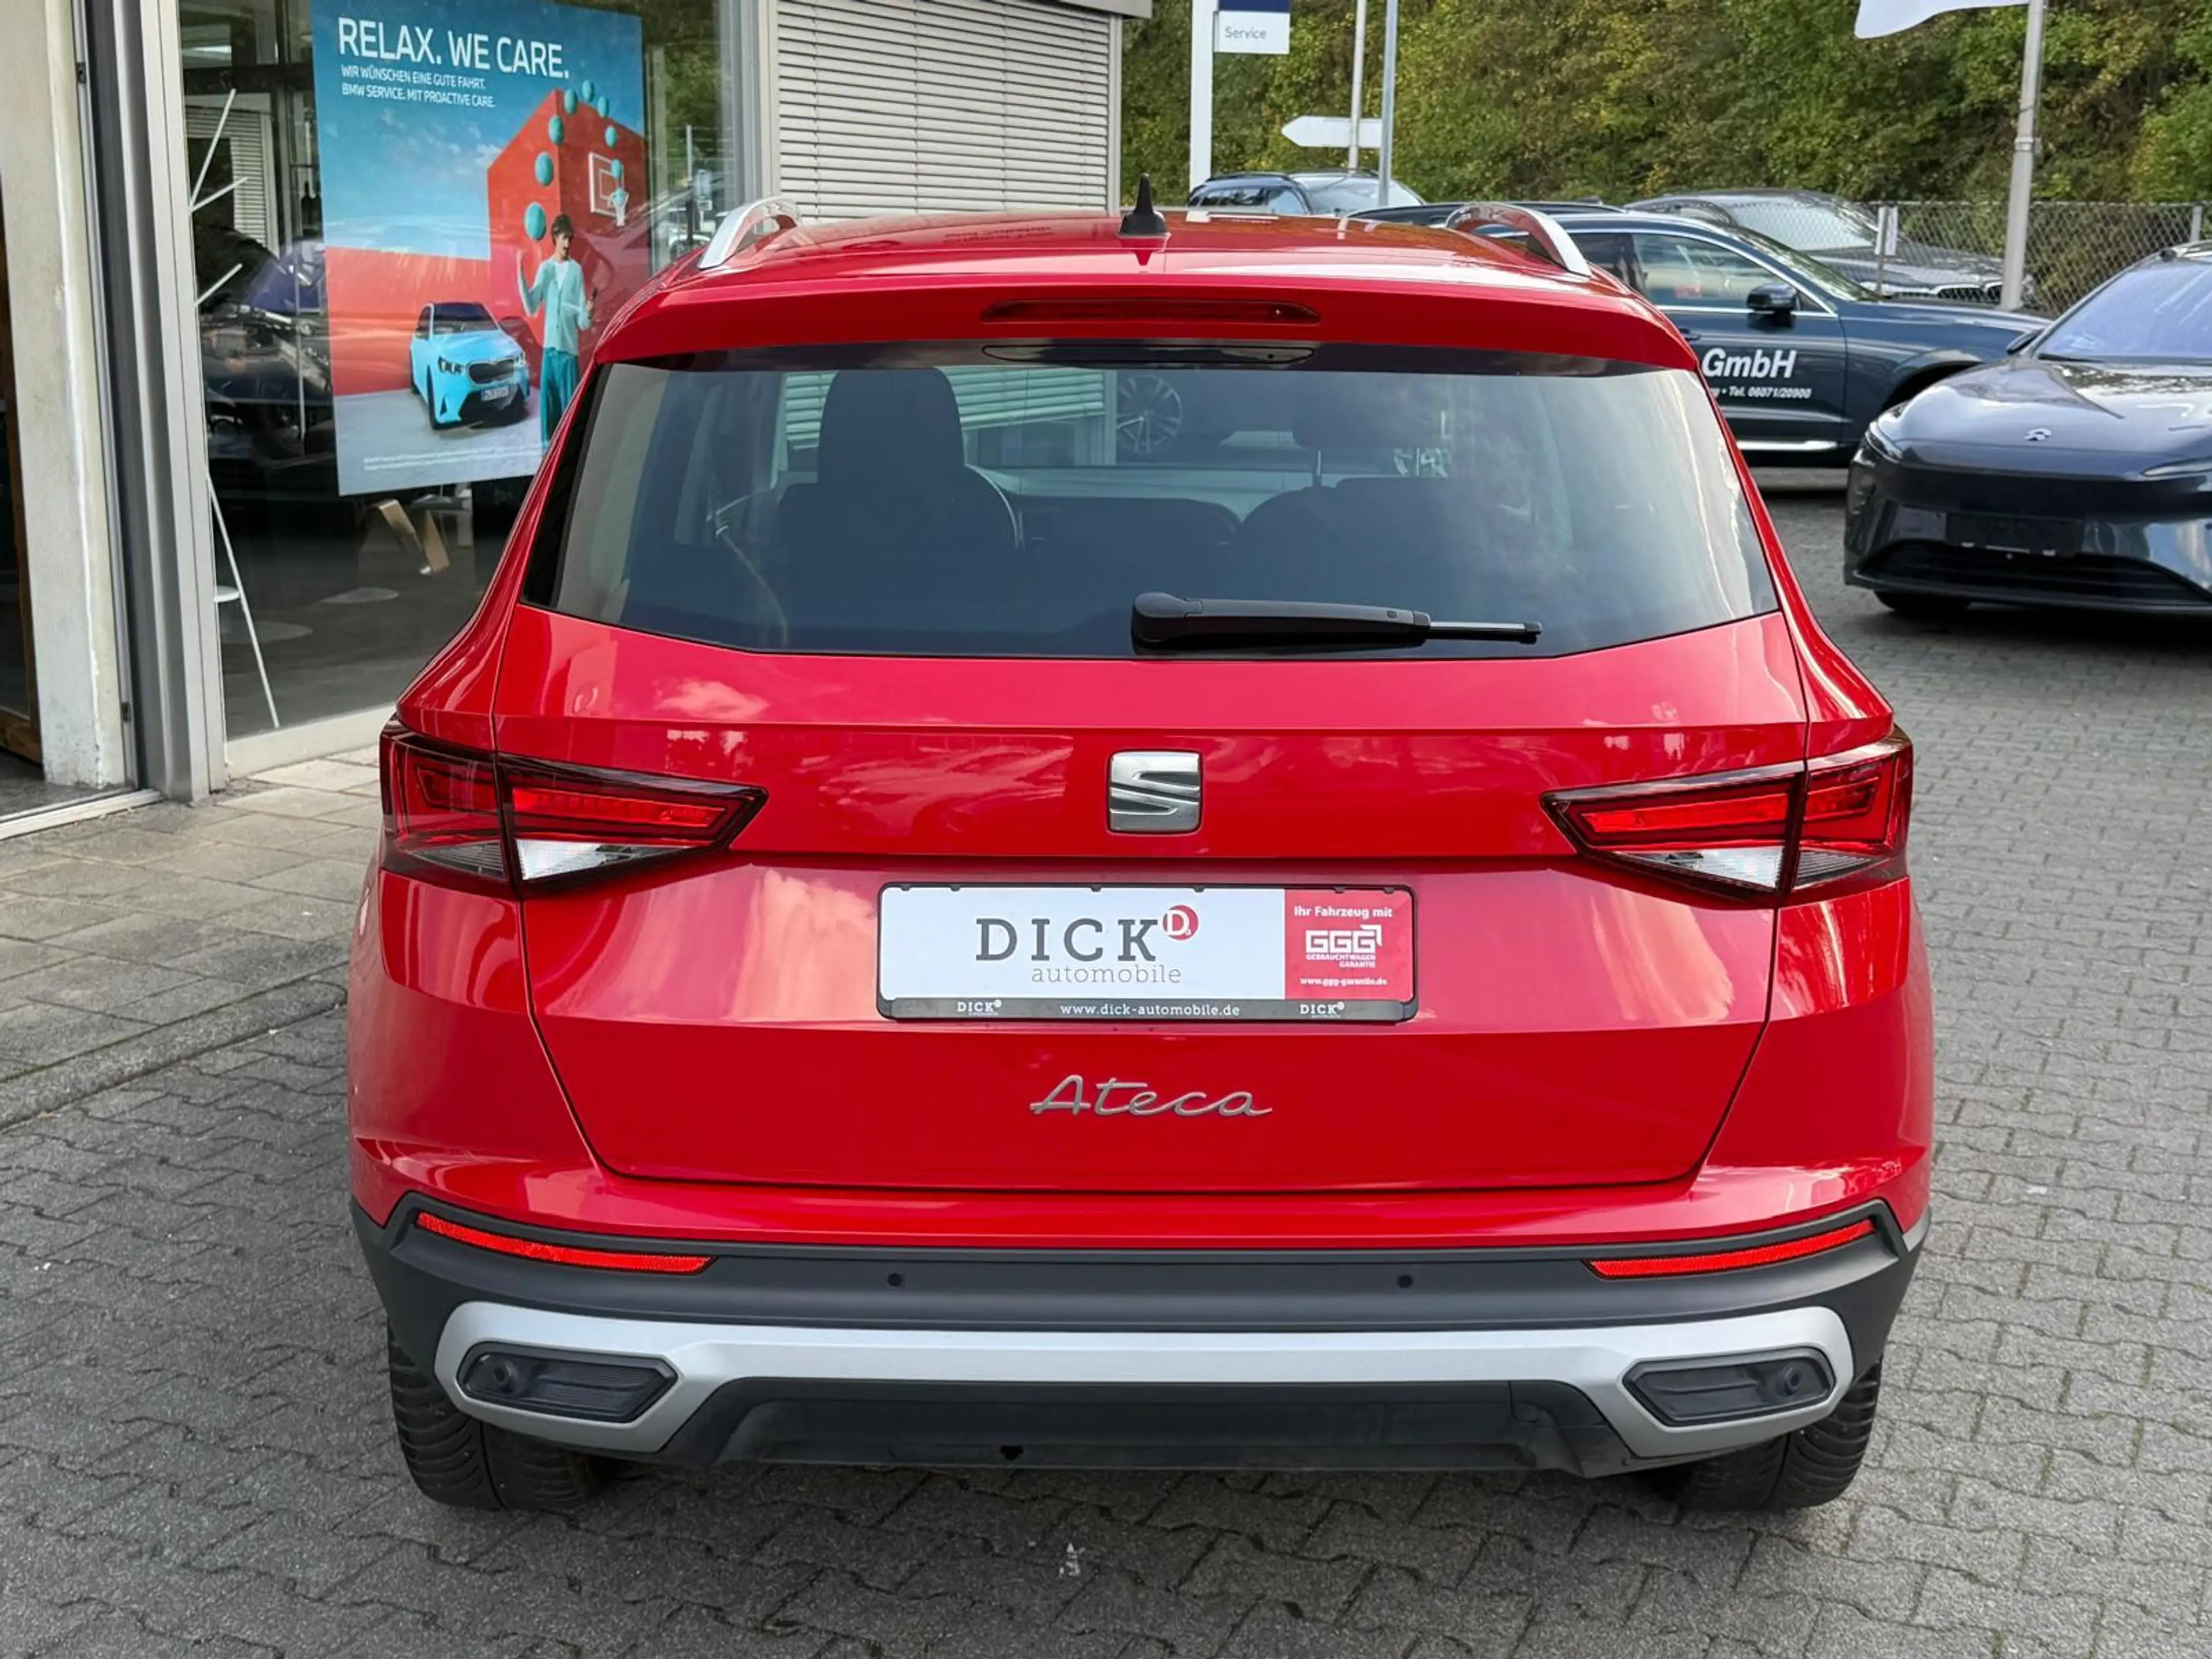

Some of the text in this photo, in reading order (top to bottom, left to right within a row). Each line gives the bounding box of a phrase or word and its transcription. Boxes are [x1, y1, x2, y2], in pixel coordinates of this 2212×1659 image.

[1224, 25, 1267, 40] Service
[338, 17, 569, 78] RELAX. WE CARE.
[341, 64, 486, 89] WIR WÜNSCHEN EINE GUTE FAHRT.
[342, 82, 364, 97] BMW
[406, 88, 424, 101] MIT
[424, 89, 471, 106] PROACTIVE
[471, 94, 497, 108] CARE.
[1702, 347, 1798, 378] GmbH
[1729, 385, 1745, 397] Tel.
[1294, 905, 1393, 920] Ihr Fahrzeug mit
[975, 918, 1158, 962] DICK
[1305, 929, 1377, 954] GGG
[1339, 961, 1376, 969] GARANTIE
[1031, 964, 1181, 984] automobile
[1300, 978, 1388, 987] www.ggg-garantie.de
[957, 1001, 995, 1013] DICK
[1060, 1003, 1240, 1017] www.dick-automobile.de
[1300, 1003, 1338, 1015] DICK
[1029, 1074, 1273, 1116] Ateca
